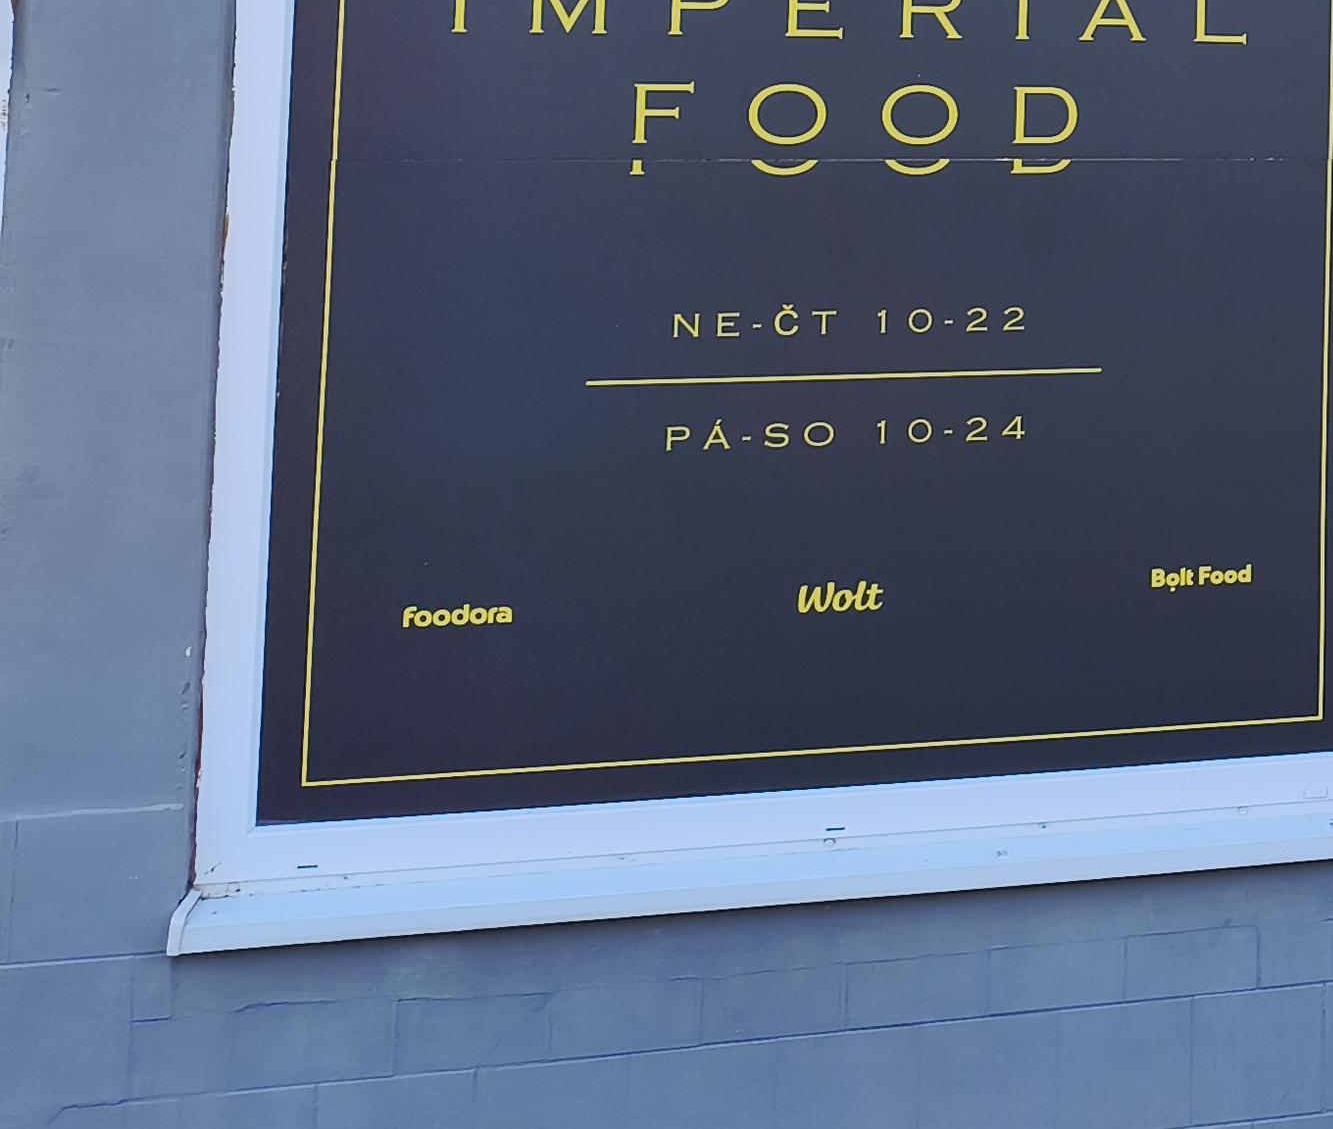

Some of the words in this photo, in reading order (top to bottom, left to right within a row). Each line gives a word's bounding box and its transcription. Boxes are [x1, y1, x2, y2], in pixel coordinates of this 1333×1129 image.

[628, 80, 1080, 176] FOOD
[672, 303, 838, 338] NE-ČT
[877, 306, 1026, 334] 10-22
[665, 418, 835, 452] PÁ-SO
[876, 415, 1026, 445] 10-24
[1150, 566, 1195, 593] Bolt
[1198, 563, 1252, 586] Food
[797, 580, 885, 614] Wolt
[402, 603, 513, 629] foodora
